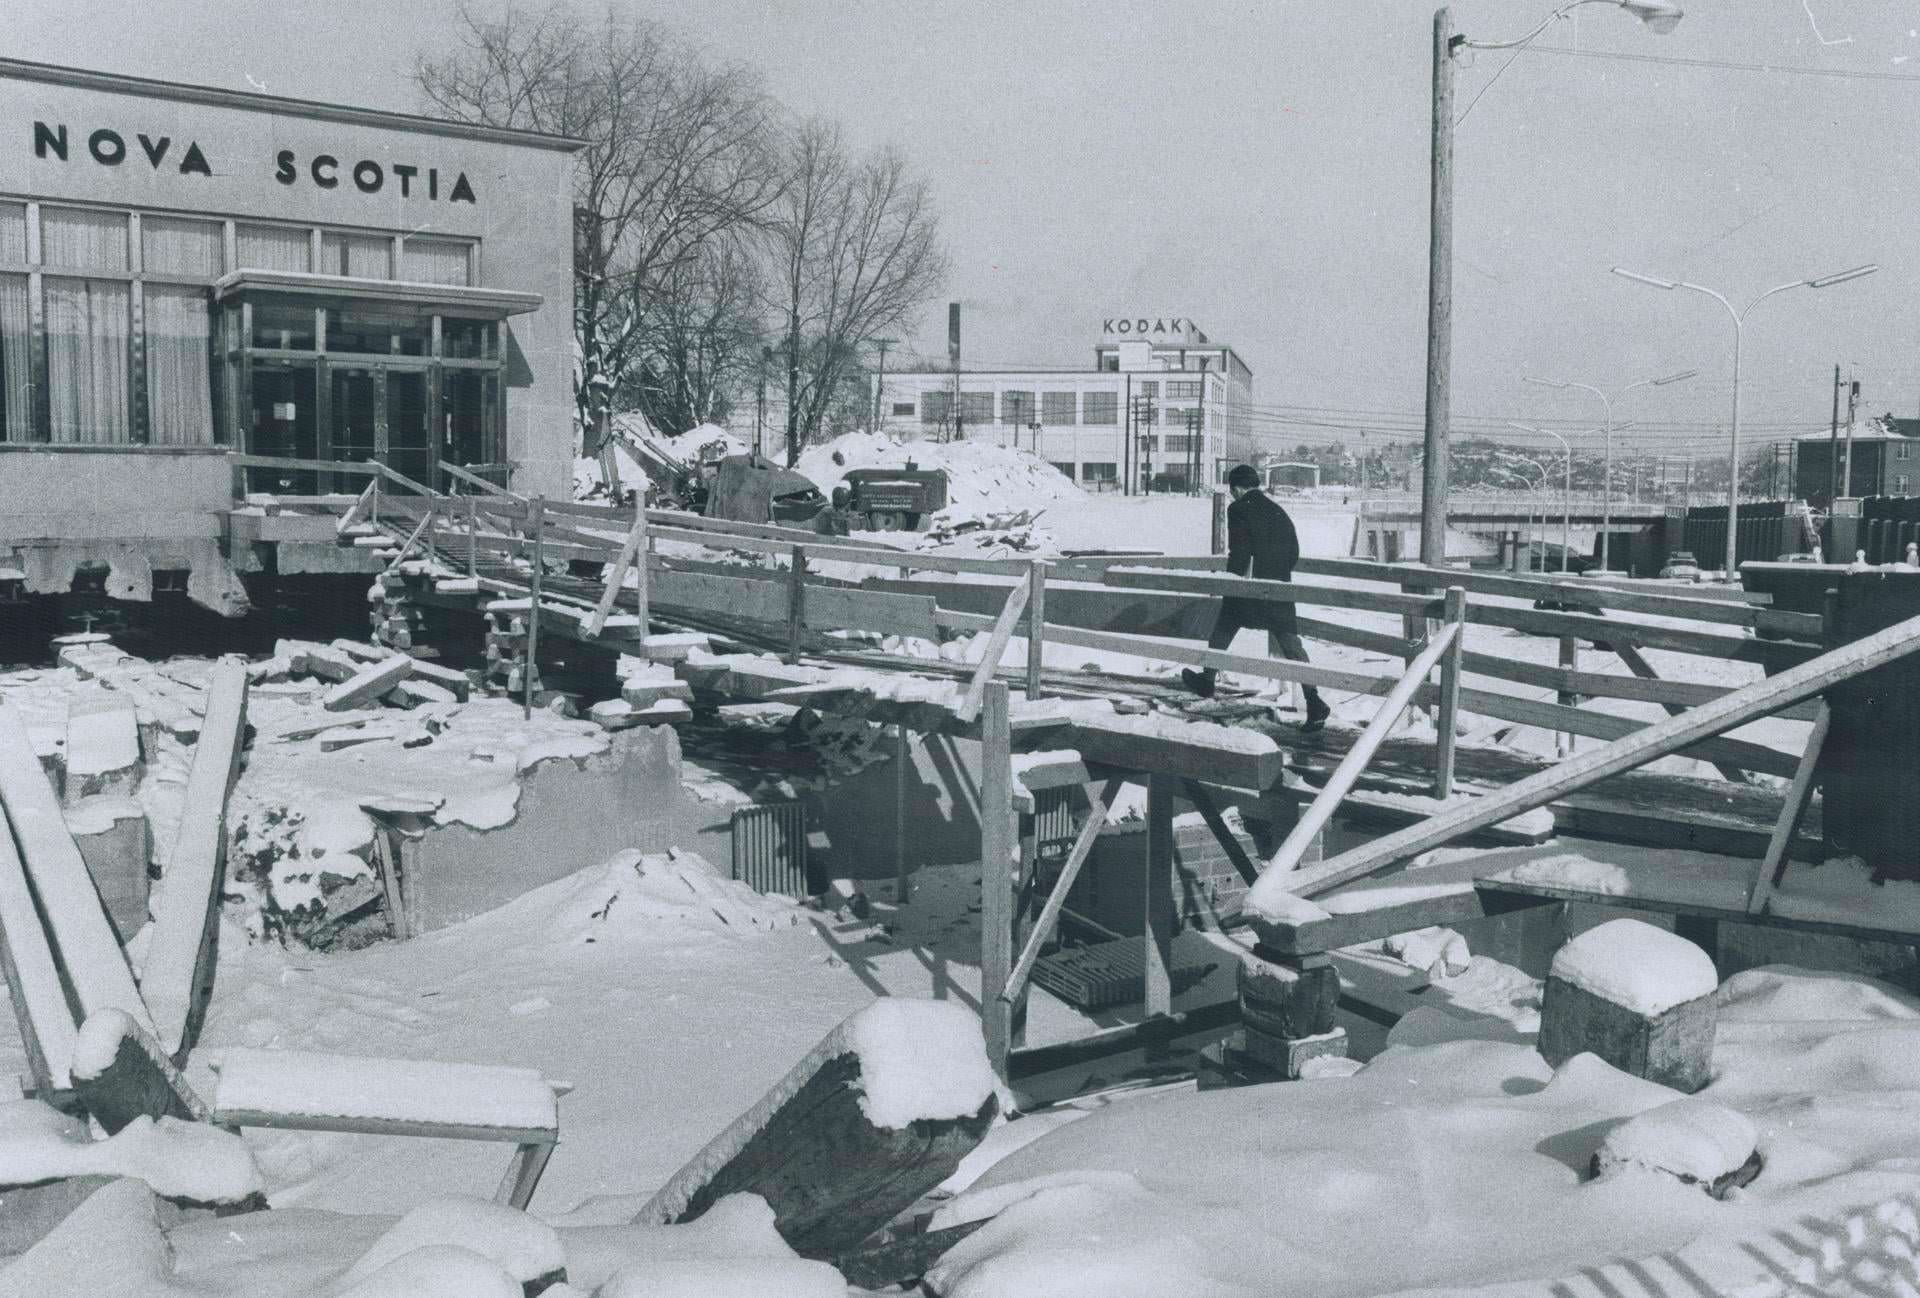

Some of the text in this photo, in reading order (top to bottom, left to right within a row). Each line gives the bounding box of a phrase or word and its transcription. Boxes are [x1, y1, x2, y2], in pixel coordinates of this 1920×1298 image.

[34, 121, 476, 205] NOVA SCOTIA
[1103, 318, 1182, 334] KODAK
